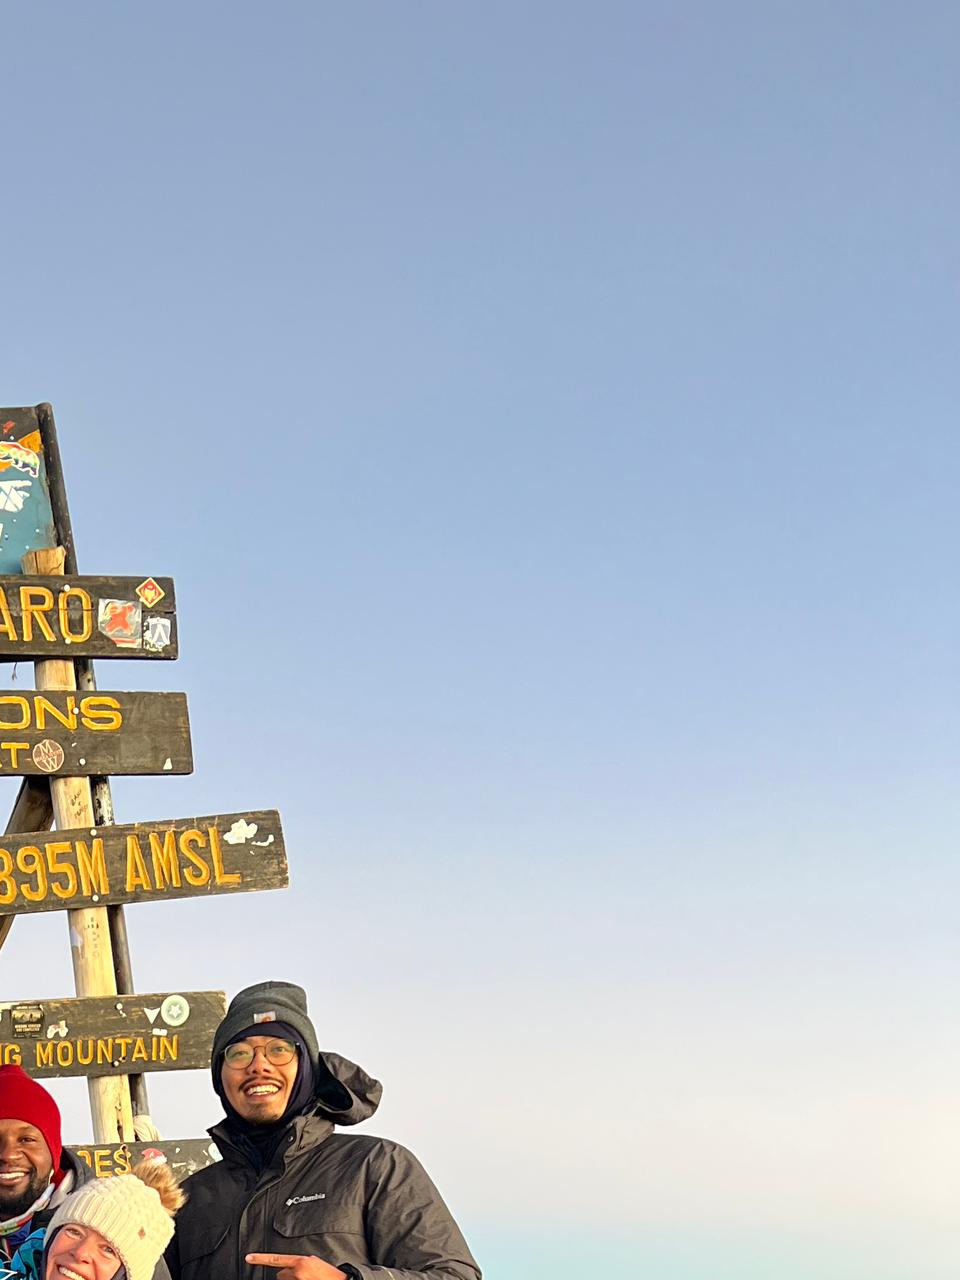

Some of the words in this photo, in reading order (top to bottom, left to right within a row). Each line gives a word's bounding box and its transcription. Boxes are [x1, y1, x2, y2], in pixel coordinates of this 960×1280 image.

[124, 825, 242, 894] AMSL
[36, 1035, 179, 1067] MOUNTAIN
[292, 1193, 326, 1205] Columbia
